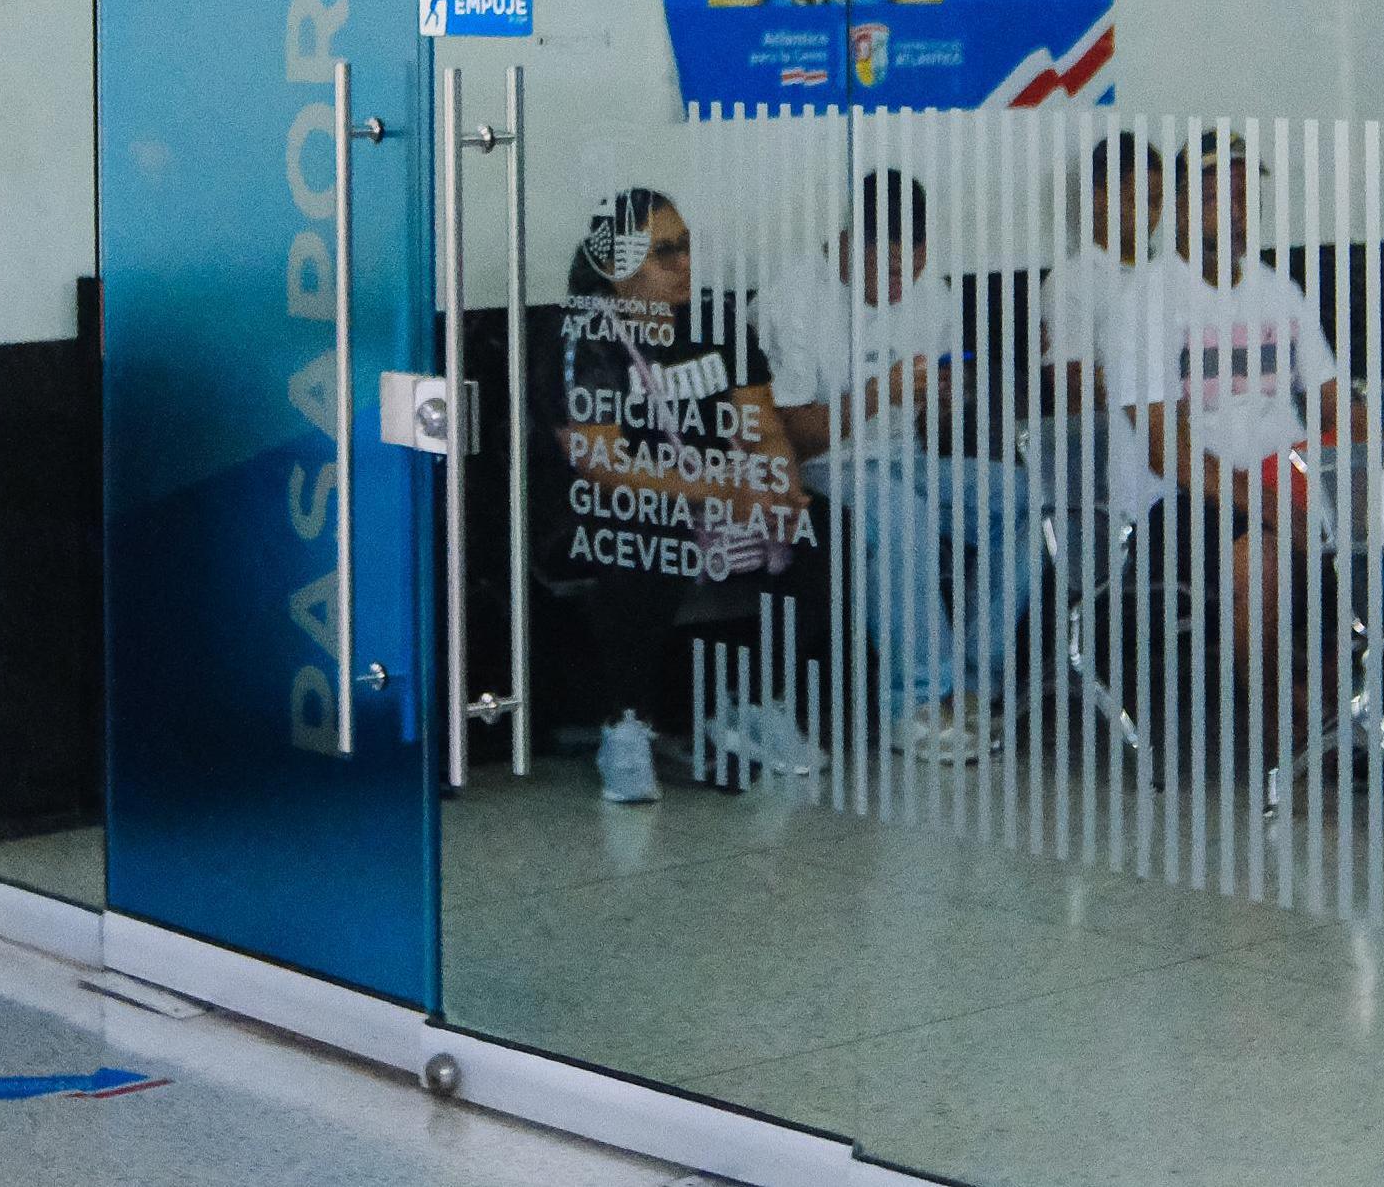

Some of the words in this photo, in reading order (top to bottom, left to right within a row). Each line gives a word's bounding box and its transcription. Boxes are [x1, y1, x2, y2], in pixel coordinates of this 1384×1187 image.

[567, 387, 705, 434] OFICINA
[716, 402, 761, 441] DE
[569, 432, 790, 494] PASAPORTES
[569, 479, 693, 530] GLORIA
[704, 497, 818, 548] PLATA
[569, 527, 730, 583] ACEVEDO
